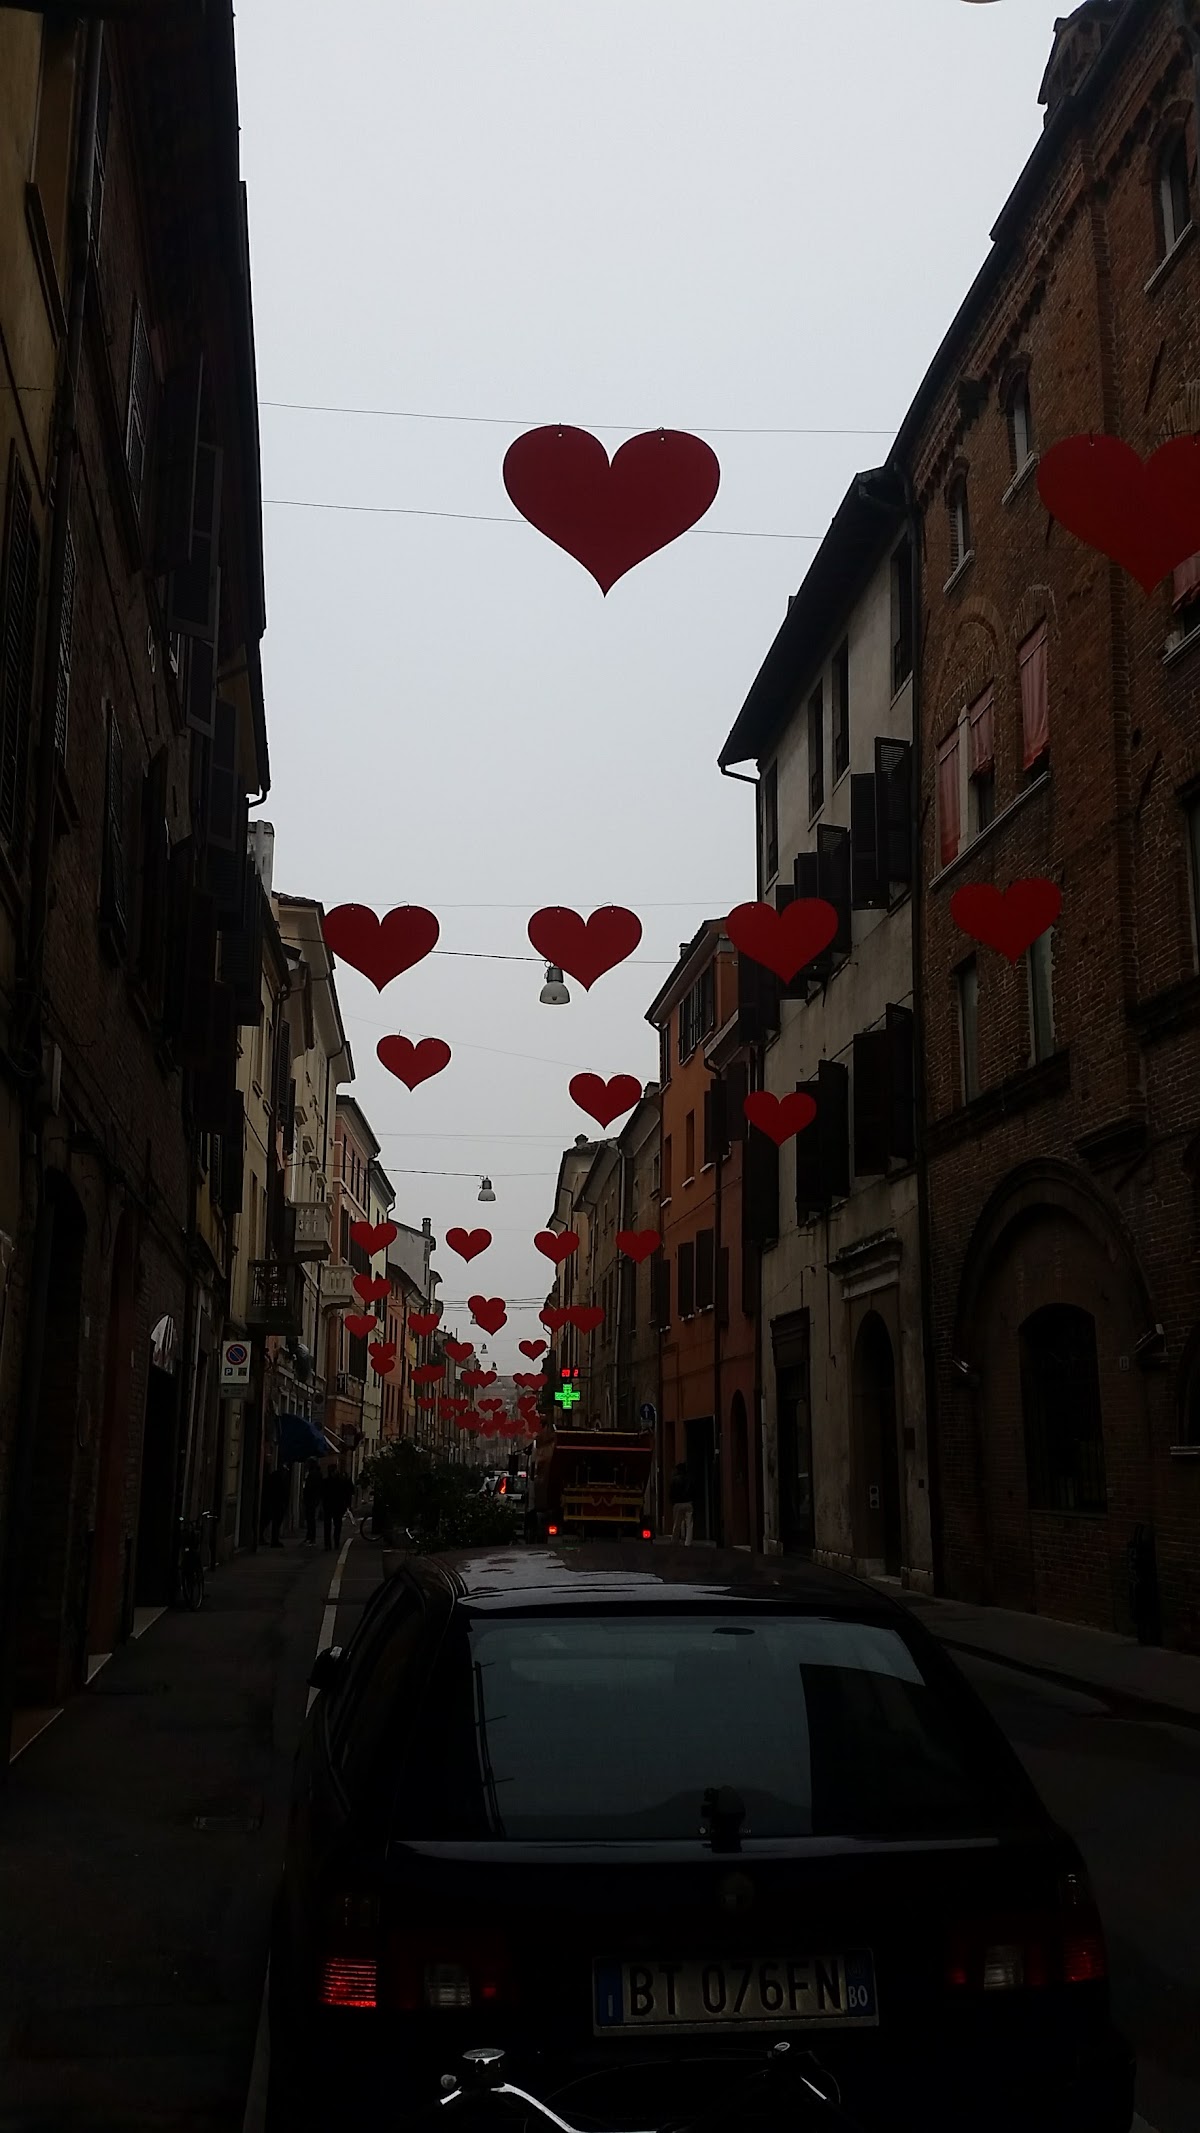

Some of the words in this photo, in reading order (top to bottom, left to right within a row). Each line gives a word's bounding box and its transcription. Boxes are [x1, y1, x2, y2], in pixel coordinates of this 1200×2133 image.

[630, 1964, 683, 2016] BT
[701, 1959, 842, 2013] 076FN
[848, 1984, 868, 2008] BO
